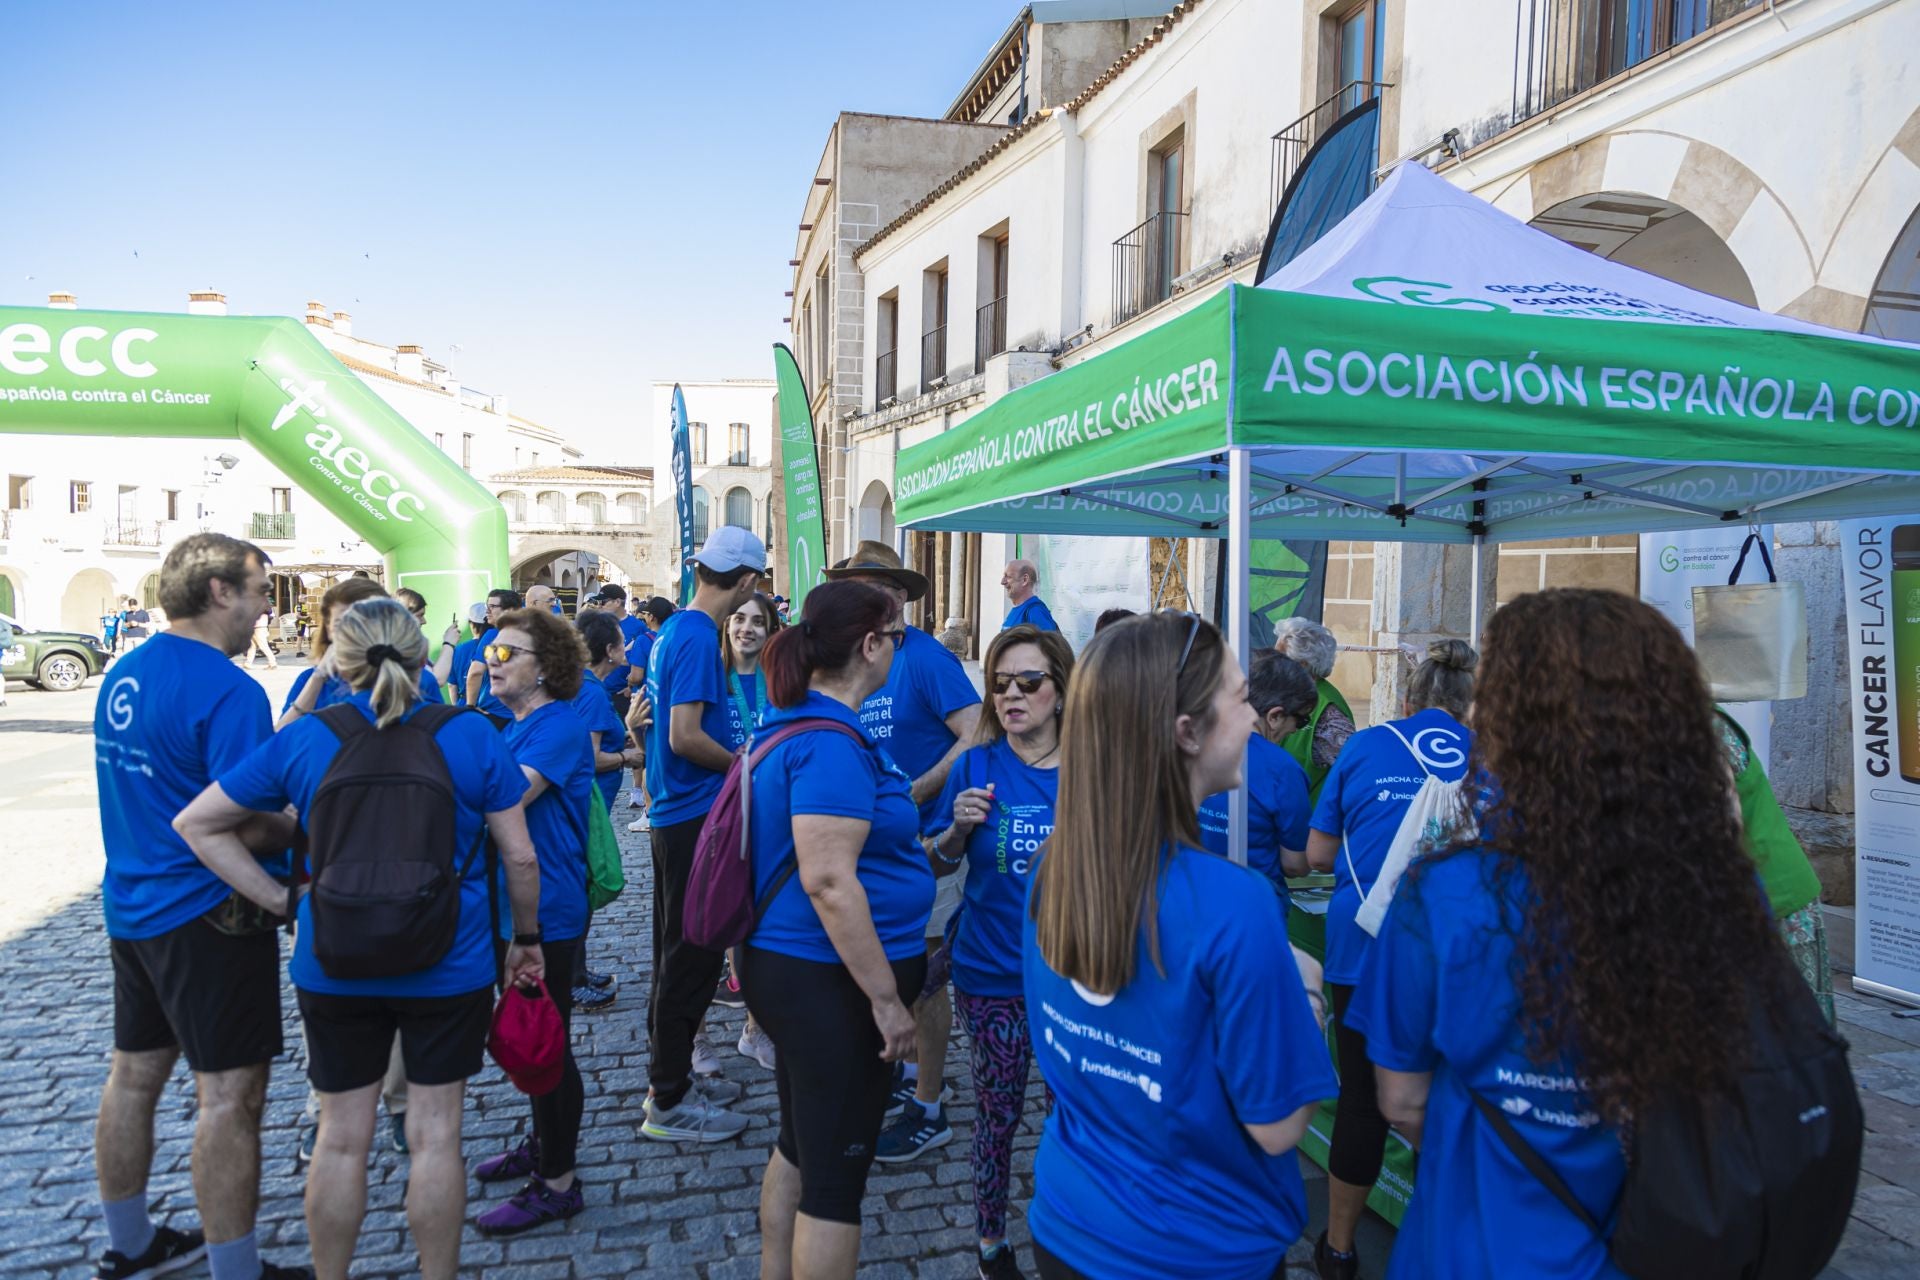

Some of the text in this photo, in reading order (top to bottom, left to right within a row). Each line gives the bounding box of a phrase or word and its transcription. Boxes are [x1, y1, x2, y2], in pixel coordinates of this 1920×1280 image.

[1543, 308, 1592, 316] en
[1263, 346, 1588, 407] ASOCIACIÓN
[1600, 365, 1834, 424] ESPAÑOLA
[72, 388, 128, 403] contra
[132, 388, 146, 403] el
[151, 388, 211, 405] Cáncer
[897, 357, 1219, 500] ASOCIACIÓN ESPAÑOLA CONTRA EL CÁNCER
[304, 423, 426, 522] aecc
[309, 456, 387, 521] Contra el Cáncer
[1858, 527, 1890, 778] CANCER FLAVOR
[864, 695, 893, 709] marcha
[860, 706, 893, 724] ontra el
[1376, 776, 1412, 785] MARCHA
[1013, 819, 1035, 834] En
[1104, 1032, 1118, 1048] EL
[1081, 1057, 1140, 1086] fundación
[1497, 1066, 1578, 1092] MARCHA
